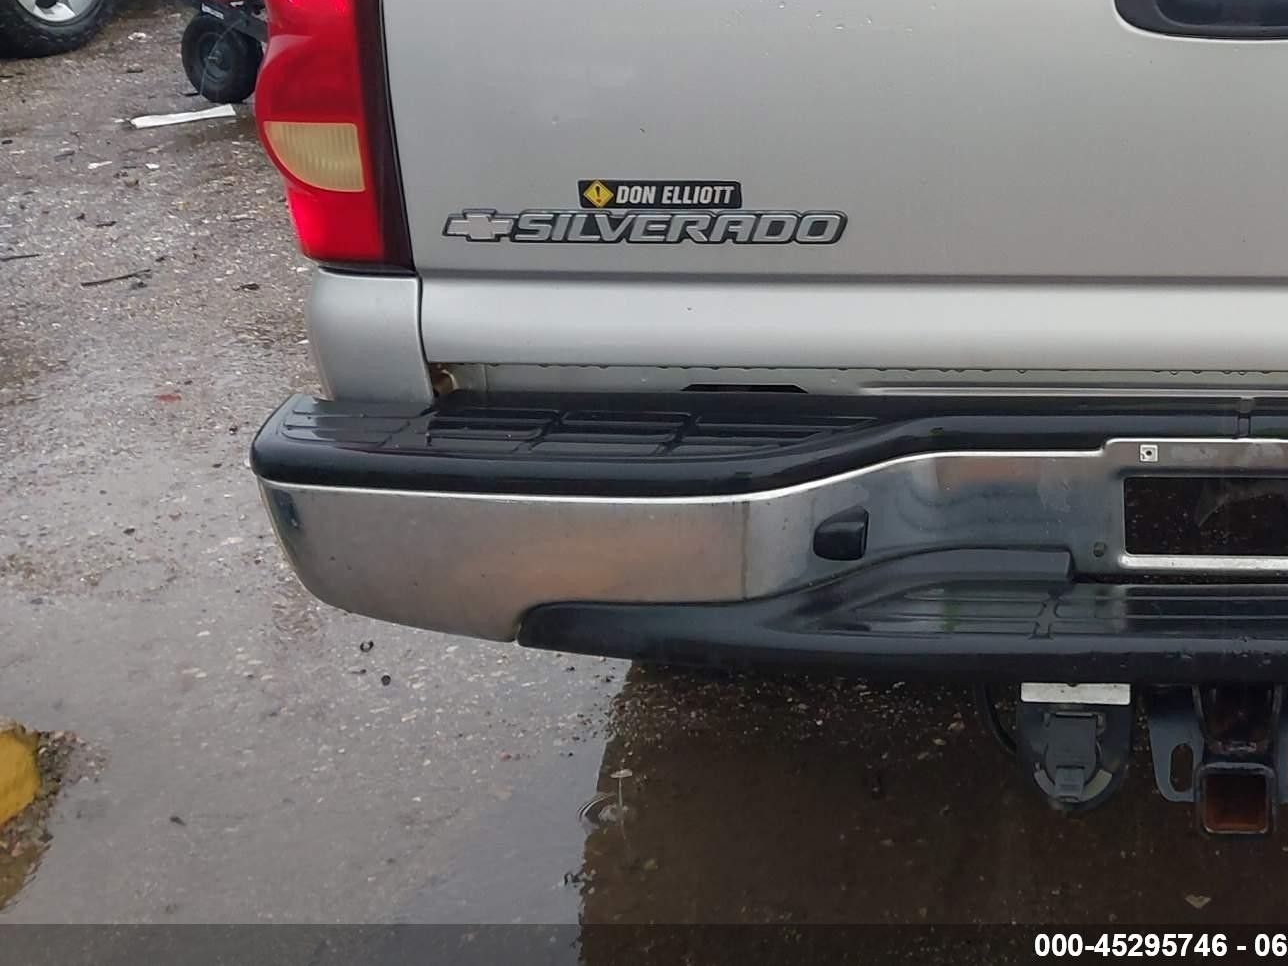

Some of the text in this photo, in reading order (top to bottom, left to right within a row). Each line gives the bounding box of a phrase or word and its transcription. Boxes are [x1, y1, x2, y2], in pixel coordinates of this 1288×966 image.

[616, 185, 735, 205] DON ELLIOTT
[511, 209, 848, 244] SILVERADO
